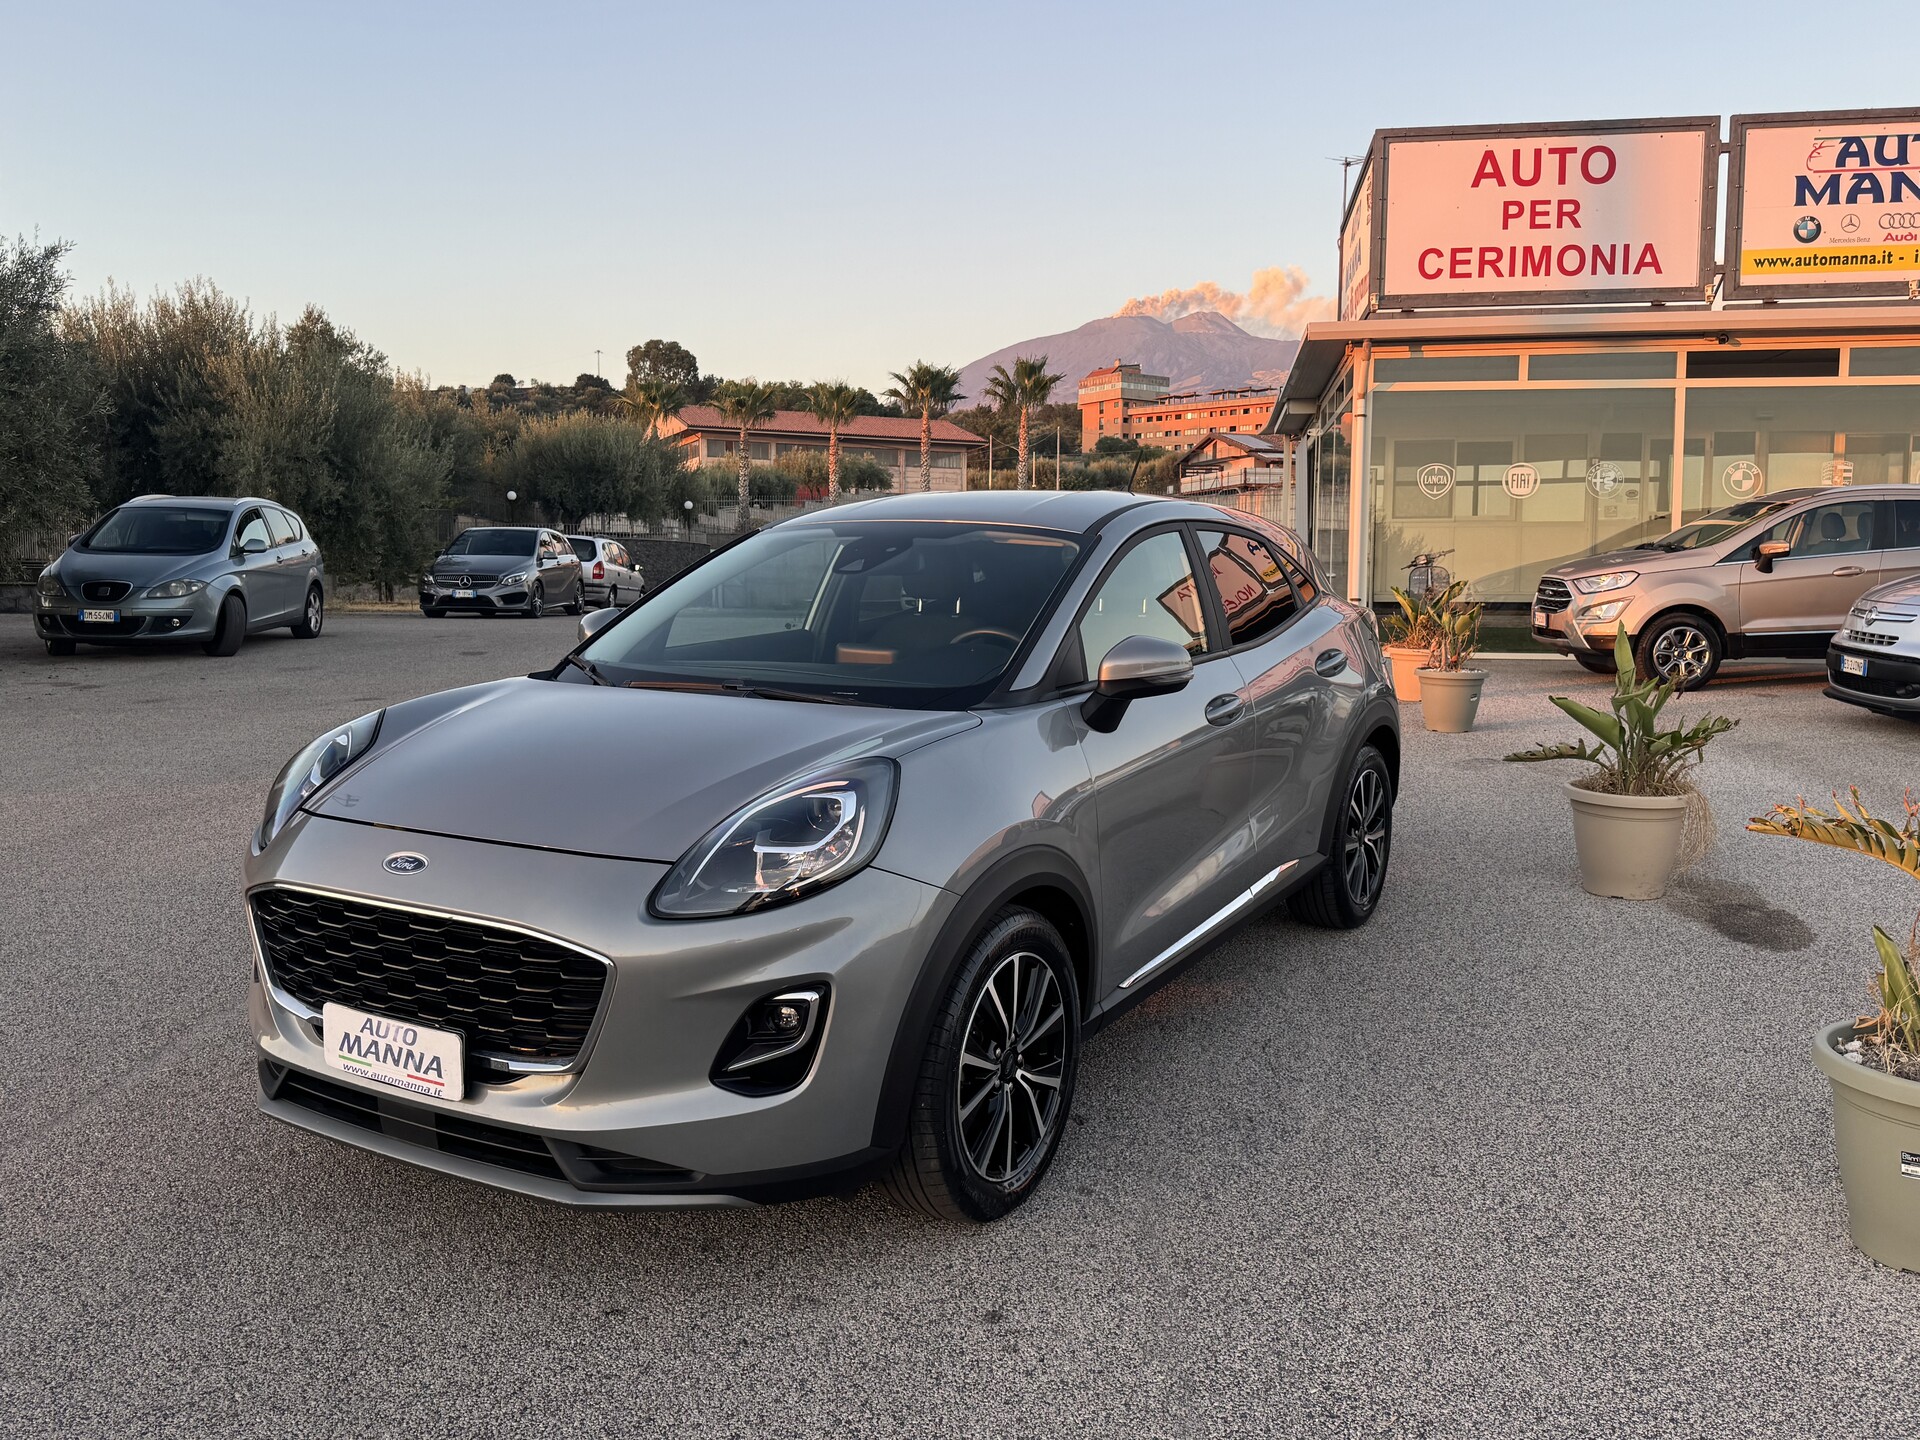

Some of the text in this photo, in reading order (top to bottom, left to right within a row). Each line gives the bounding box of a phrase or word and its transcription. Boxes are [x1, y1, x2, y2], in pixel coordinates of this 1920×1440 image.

[1470, 145, 1617, 188] AUTO
[1835, 134, 1920, 169] AU
[1502, 199, 1582, 230] PER
[1883, 231, 1918, 242] Audi
[1418, 242, 1663, 280] CERIMONIA
[1753, 250, 1894, 268] www.automanna.it
[1424, 475, 1448, 485] LANCIA
[1510, 473, 1531, 490] FIAT
[391, 857, 419, 870] Ford
[360, 1018, 418, 1047] AUTO
[339, 1032, 444, 1079] MANNA
[343, 1063, 443, 1097] www.automanna.it
